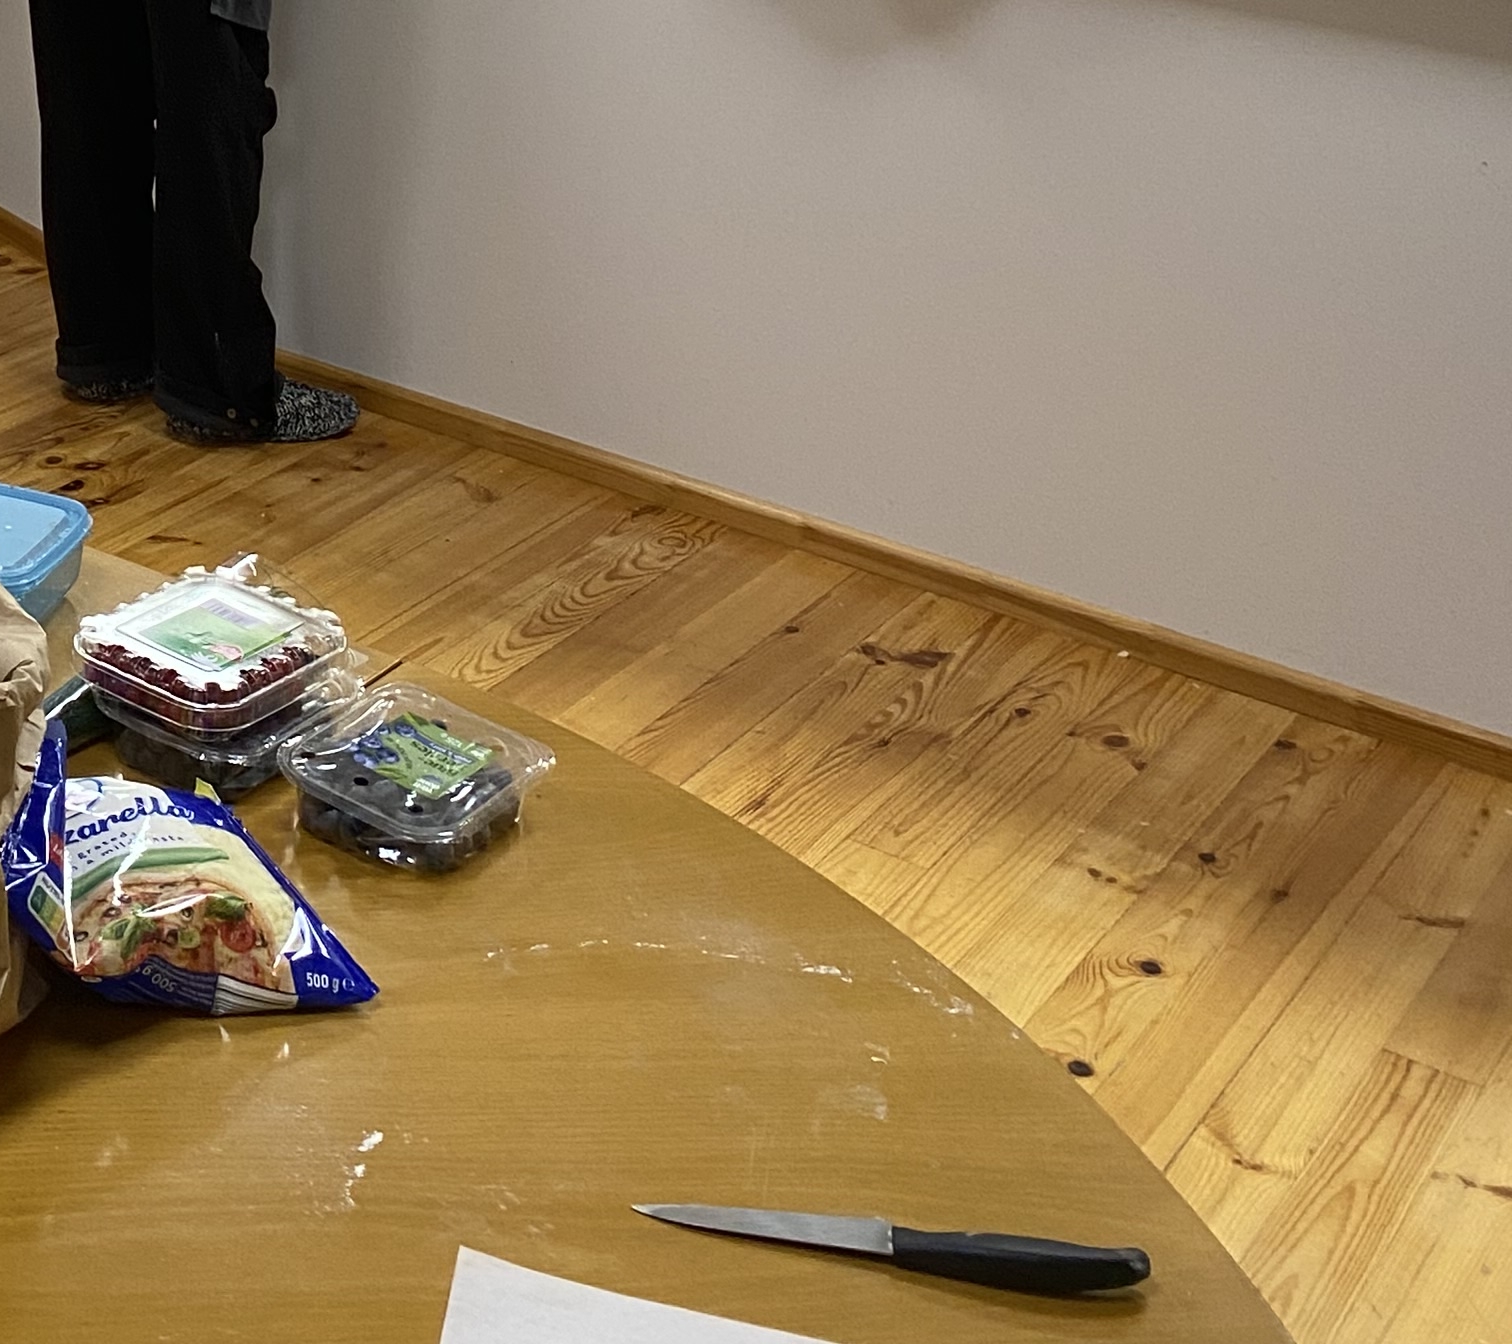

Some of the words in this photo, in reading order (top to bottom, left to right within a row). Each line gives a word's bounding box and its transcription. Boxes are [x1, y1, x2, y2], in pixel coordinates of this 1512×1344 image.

[64, 796, 194, 844] zarella
[306, 972, 329, 989] 500
[332, 979, 340, 992] g
